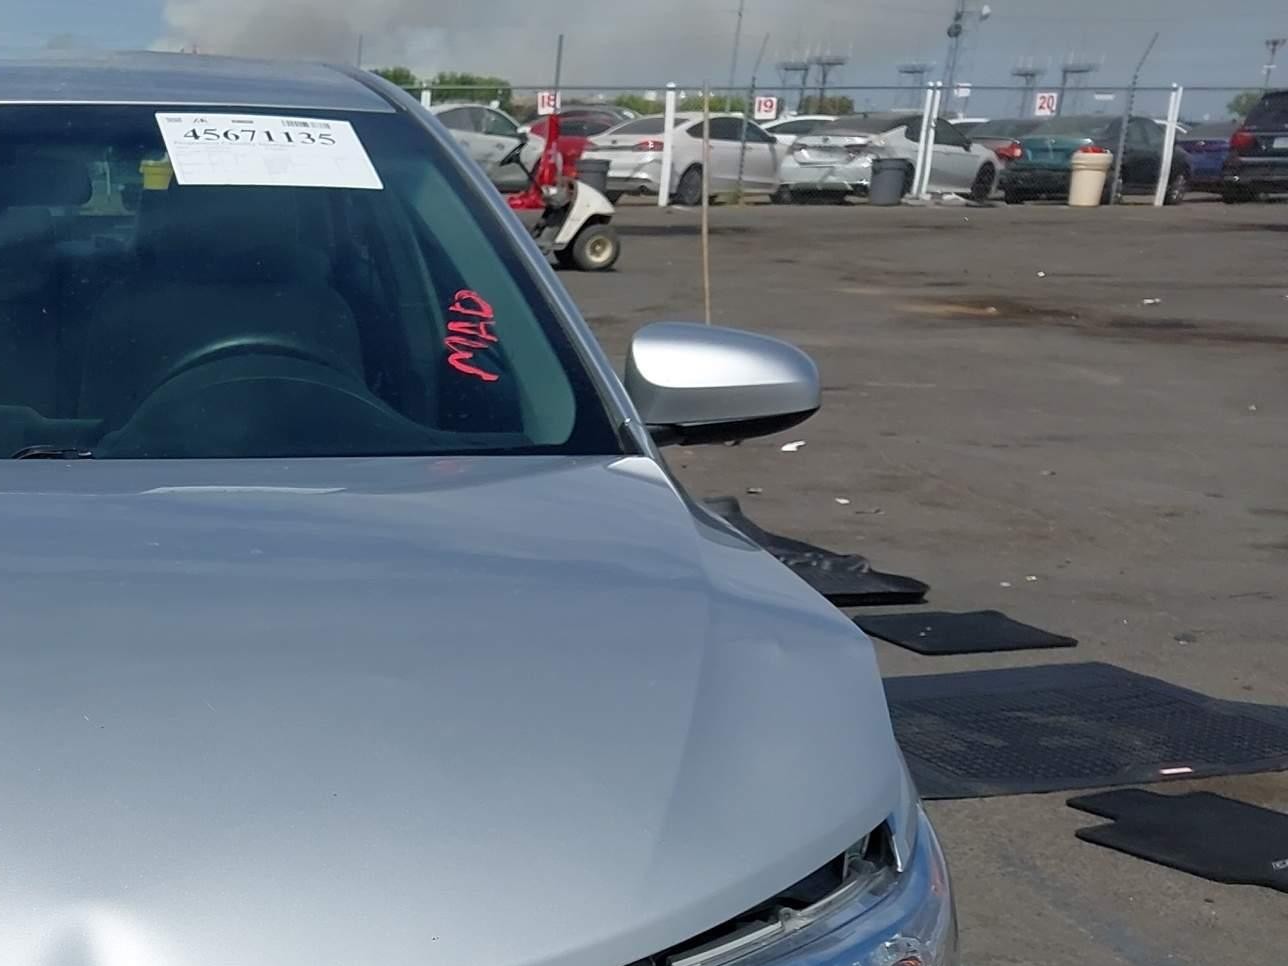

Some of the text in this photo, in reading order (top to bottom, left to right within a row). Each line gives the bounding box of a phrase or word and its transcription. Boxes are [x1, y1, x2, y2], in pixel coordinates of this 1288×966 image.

[758, 99, 774, 112] 19
[1039, 95, 1055, 110] 20
[184, 128, 336, 146] 45671135
